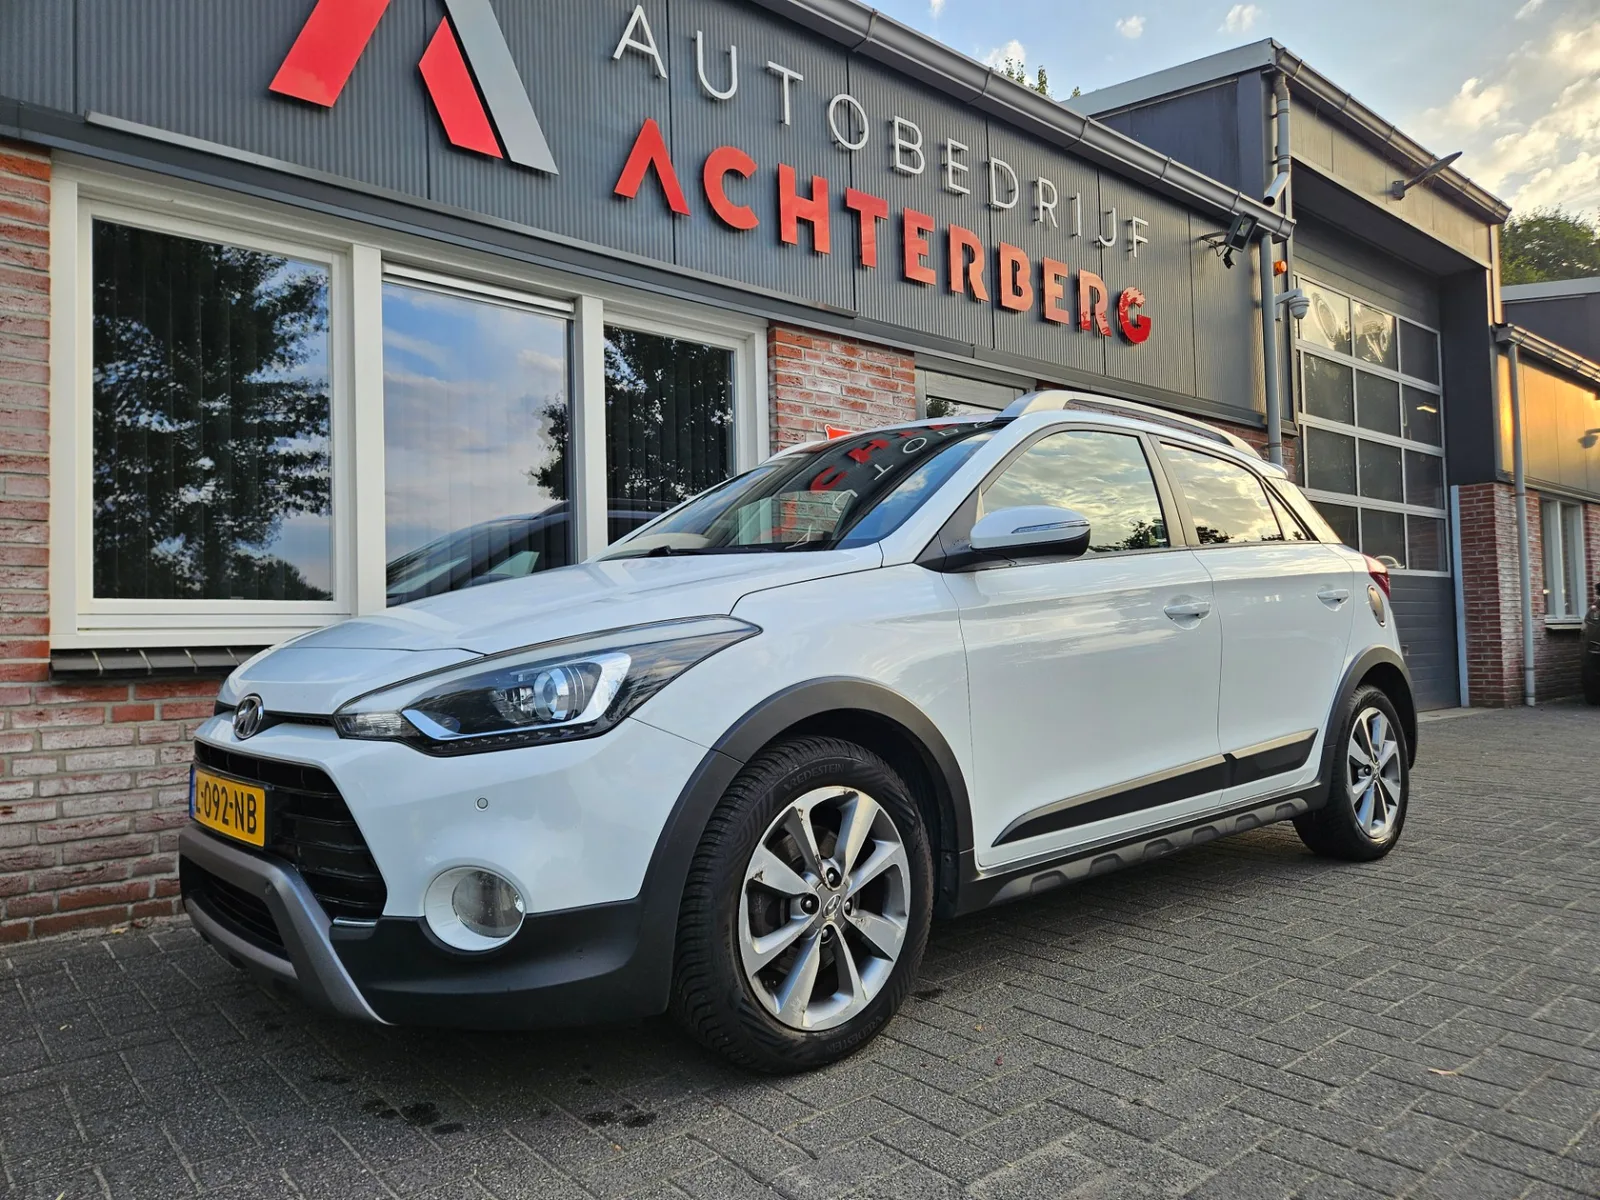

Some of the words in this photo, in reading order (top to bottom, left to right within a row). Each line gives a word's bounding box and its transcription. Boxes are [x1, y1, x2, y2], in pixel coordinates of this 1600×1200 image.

[612, 4, 1149, 258] AUTOBEDRIJF
[613, 117, 1152, 345] ACHTERBERG
[195, 777, 257, 835] L-092-NB
[783, 763, 845, 791] VREDESTEIN
